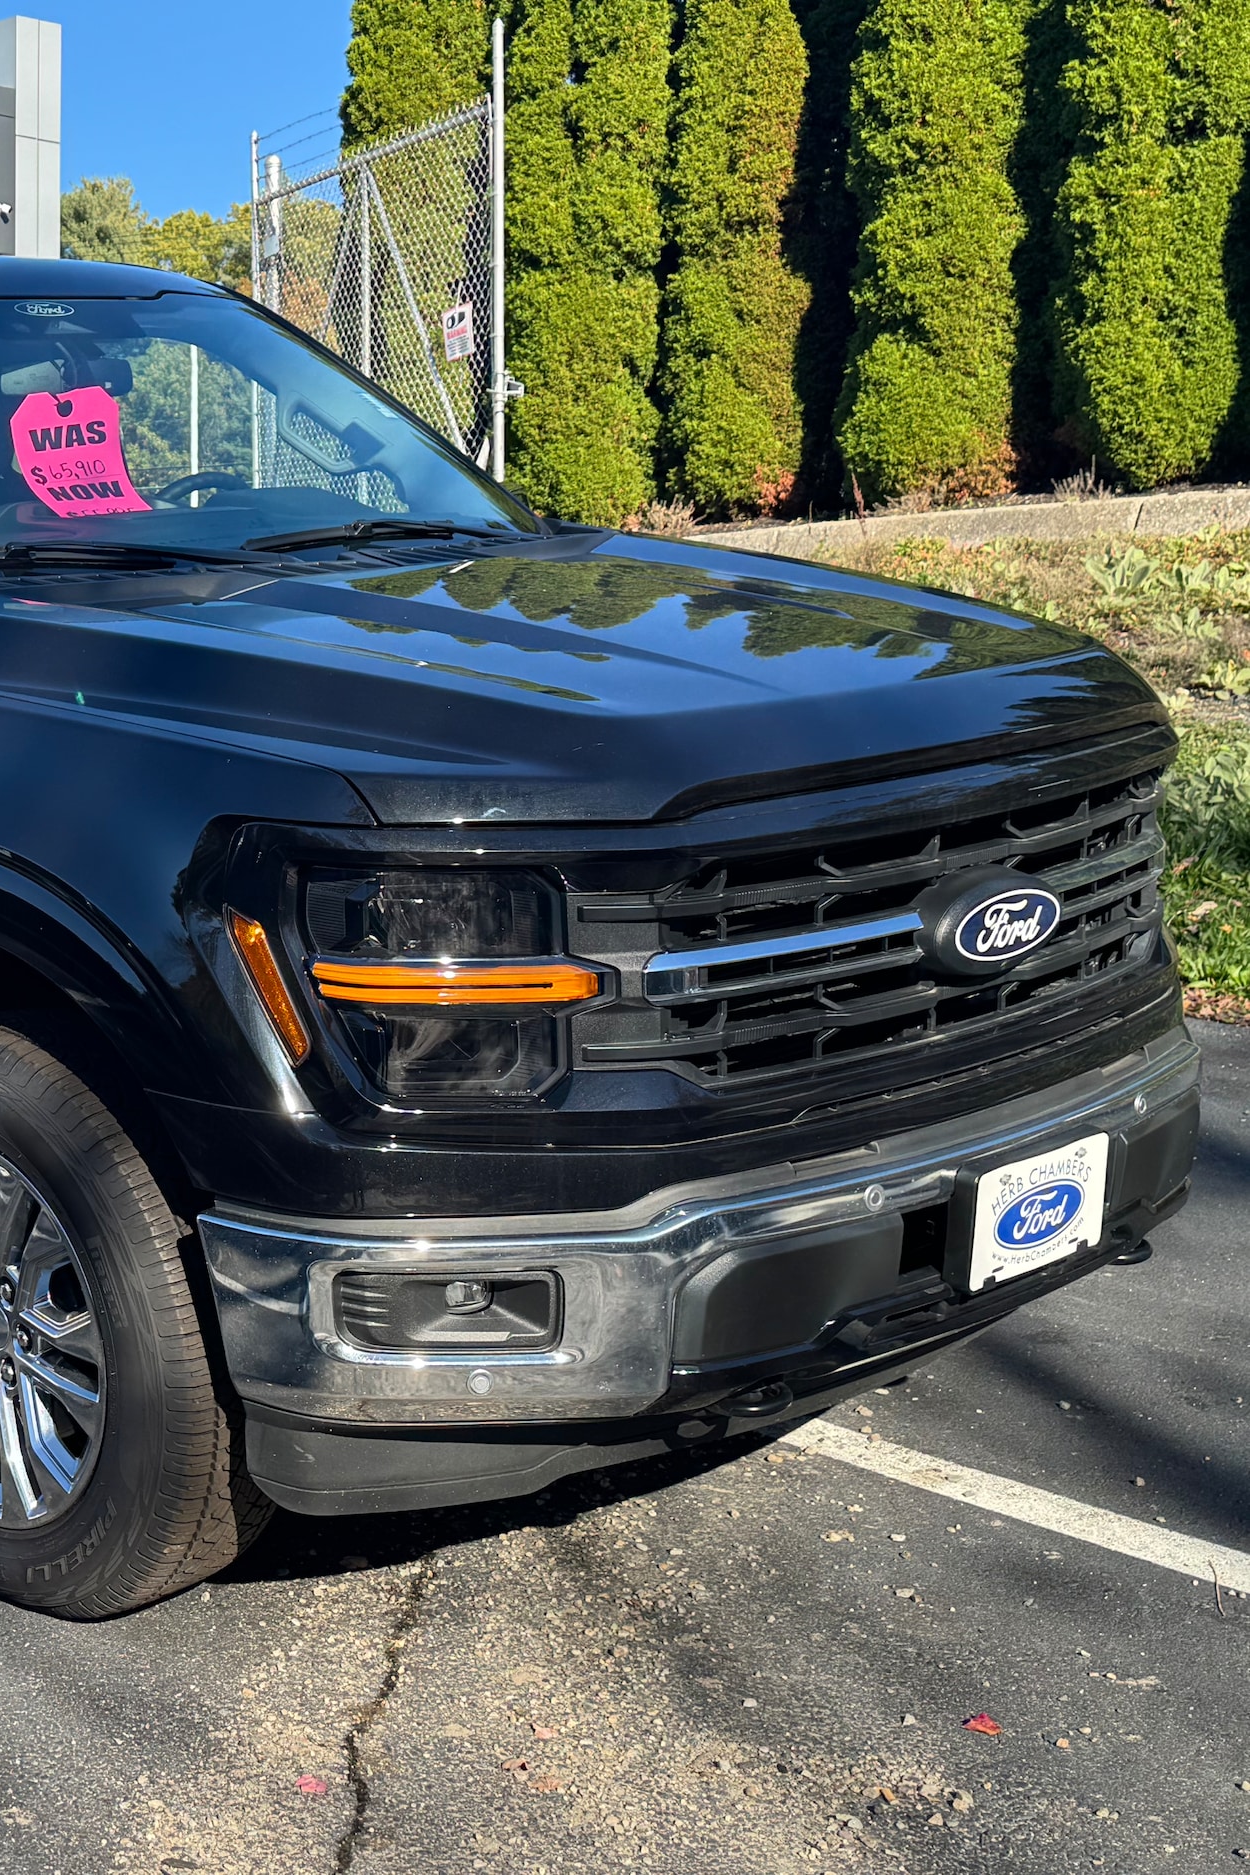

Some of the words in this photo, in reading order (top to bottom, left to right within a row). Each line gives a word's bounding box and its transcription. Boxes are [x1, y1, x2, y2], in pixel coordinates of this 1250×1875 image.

[26, 303, 66, 314] Ford
[28, 420, 107, 452] WAS
[46, 480, 125, 502] NOW
[976, 899, 1042, 954] Ford
[991, 1177, 1024, 1216] HERB
[1029, 1159, 1092, 1185] CHAMBERS
[1012, 1190, 1069, 1240] Ford
[25, 1496, 118, 1584] PIRELLI
